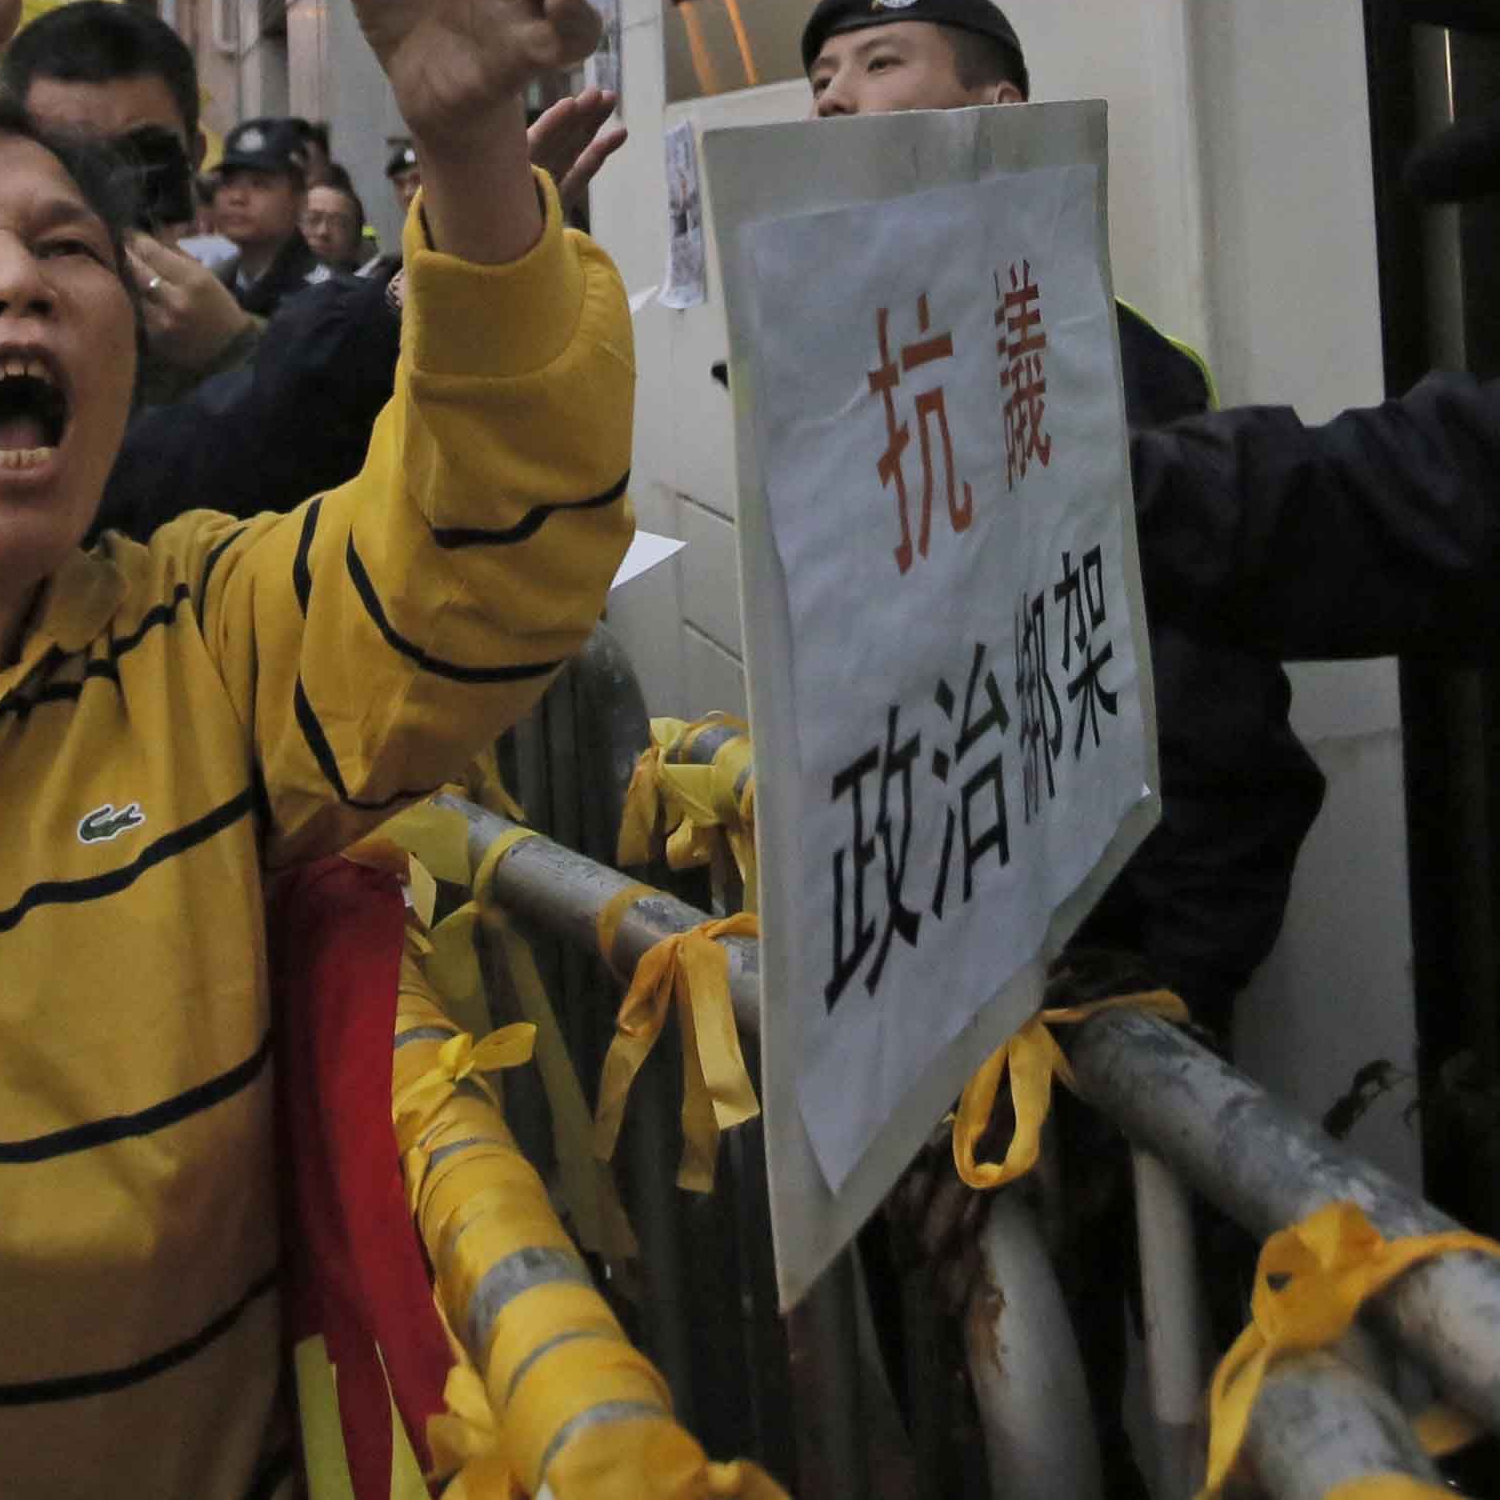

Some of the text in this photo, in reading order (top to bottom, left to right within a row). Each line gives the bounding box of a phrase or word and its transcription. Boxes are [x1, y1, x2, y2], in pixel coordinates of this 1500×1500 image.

[867, 259, 1052, 574] 抗議
[823, 544, 1119, 1015] 政治綁架
